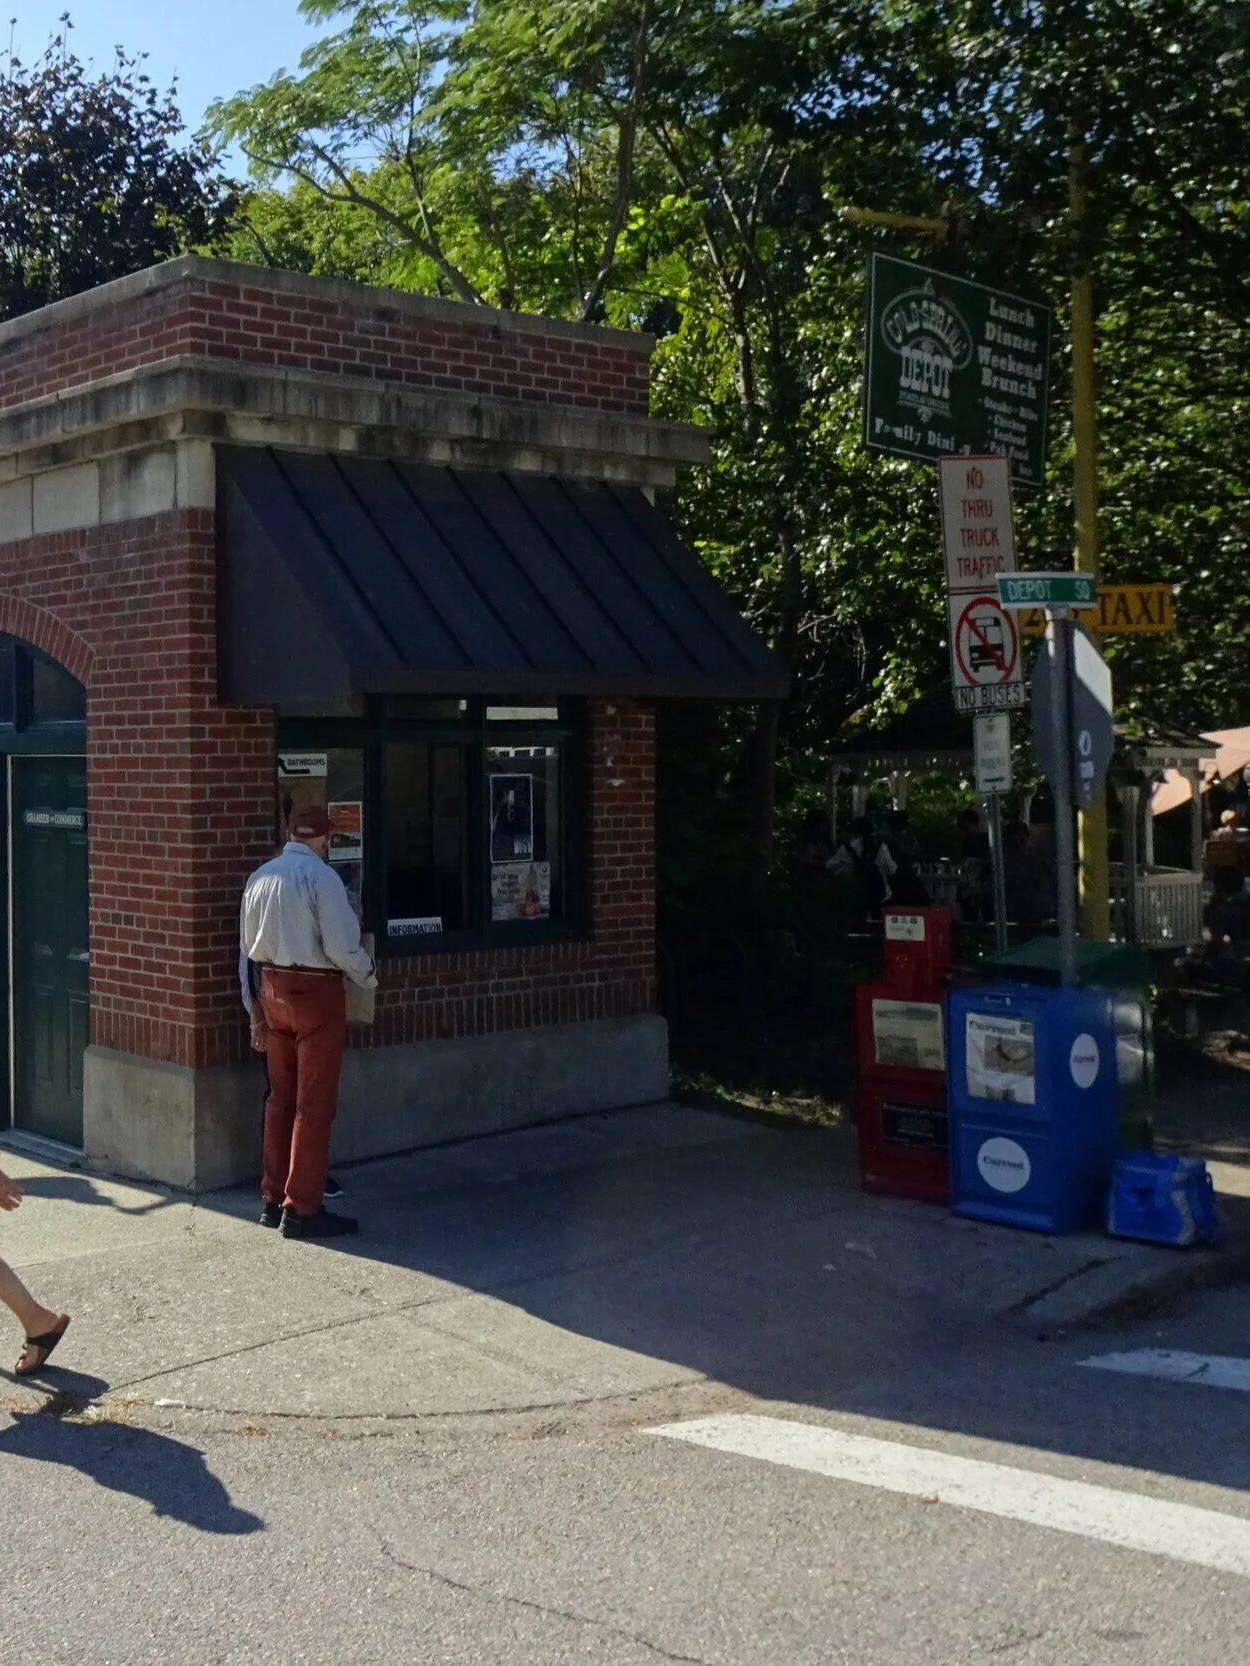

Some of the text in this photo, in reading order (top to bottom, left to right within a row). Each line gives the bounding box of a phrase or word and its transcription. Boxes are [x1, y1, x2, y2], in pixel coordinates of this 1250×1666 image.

[989, 297, 1035, 328] Lunch
[984, 321, 1038, 354] Dinner
[899, 345, 953, 399] DEPOT
[977, 345, 1043, 380] Weekend
[982, 367, 1037, 400] Brunch
[874, 417, 922, 446] Family
[965, 468, 984, 490] NO
[960, 498, 993, 518] THRU
[959, 527, 1000, 548] TRUCK
[956, 555, 1005, 579] TRAFFIC
[1007, 579, 1091, 602] DEPOT SQ
[959, 685, 1023, 708] NO BUSES
[287, 757, 326, 767] BATHROOMS
[25, 812, 50, 825] CHAMBER
[54, 813, 83, 827] COMMERCE
[388, 921, 442, 936] INFORMATION
